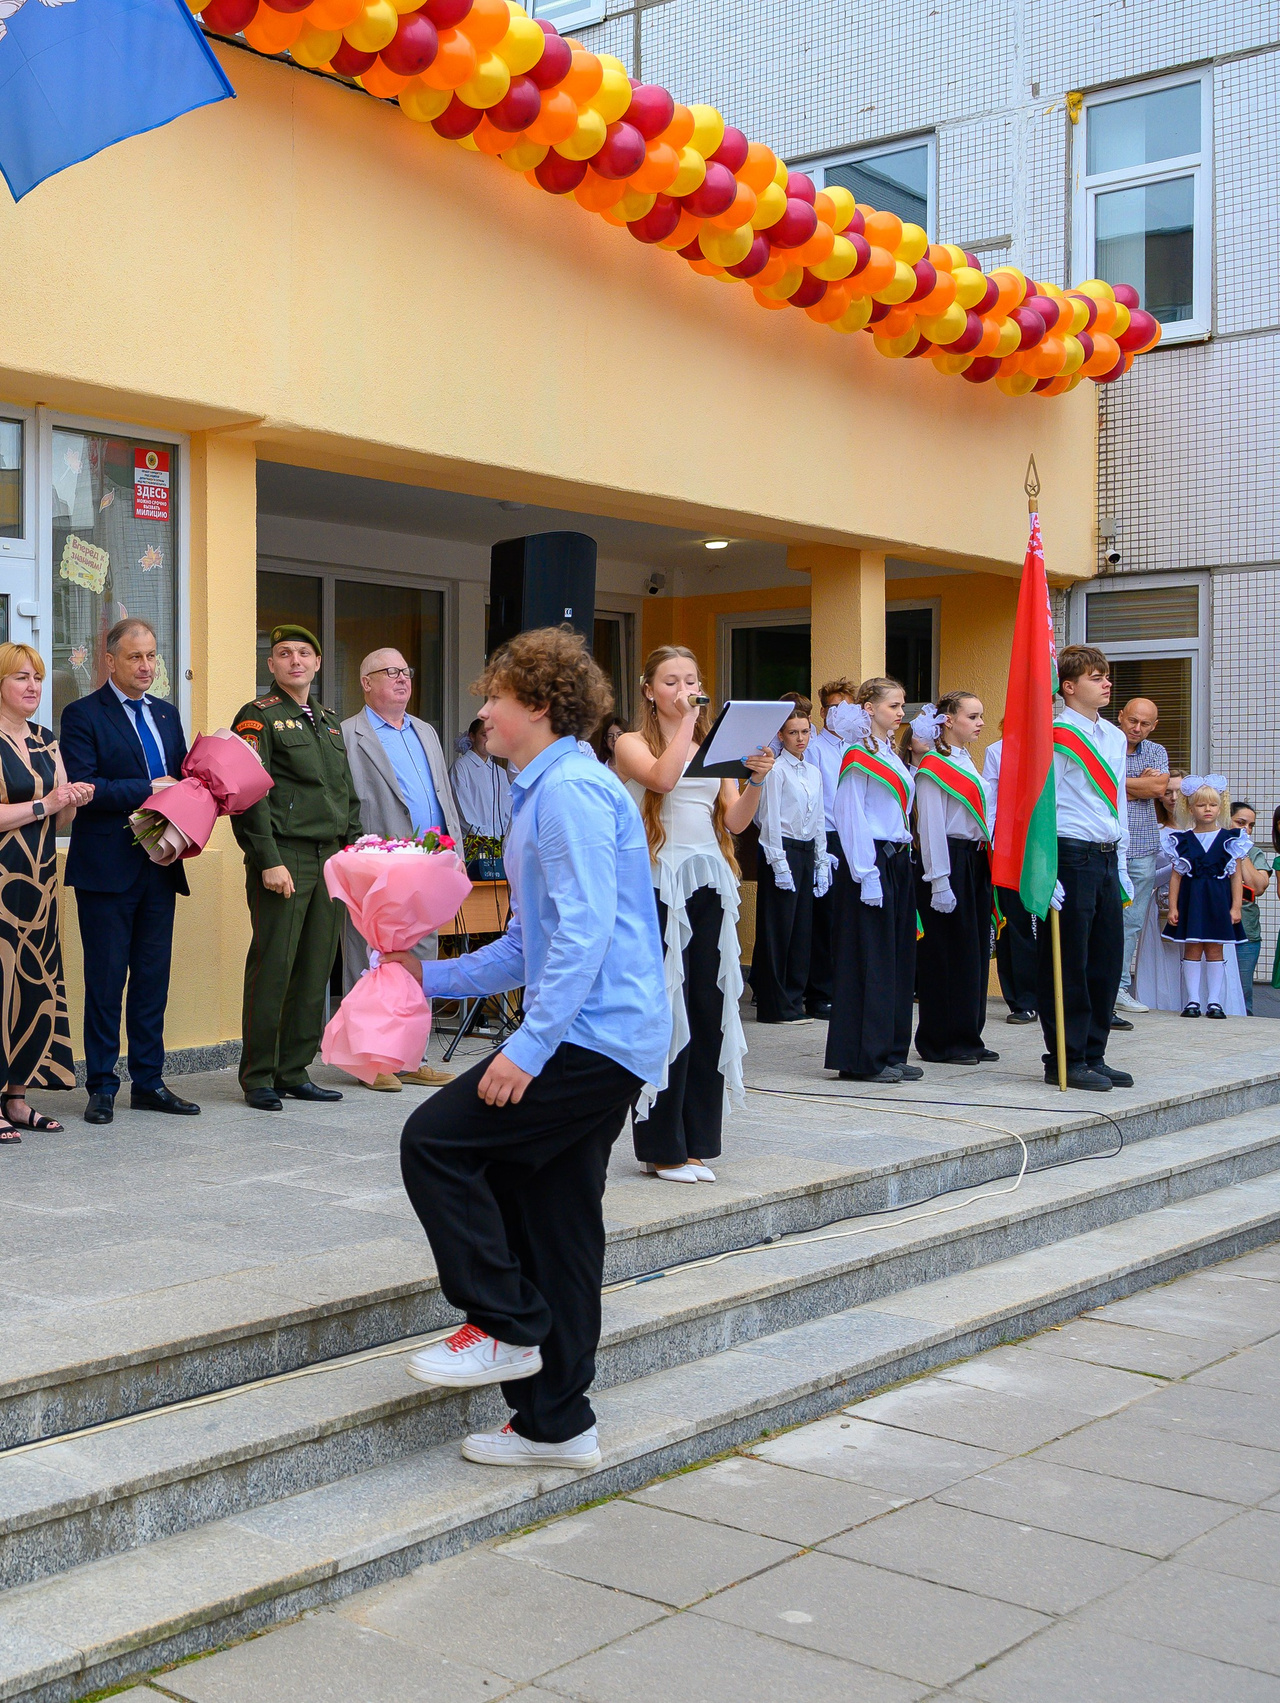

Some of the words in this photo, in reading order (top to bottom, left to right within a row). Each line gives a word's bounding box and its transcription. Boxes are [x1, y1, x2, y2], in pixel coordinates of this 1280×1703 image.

[137, 485, 167, 499] ЗДЕСЬ
[136, 509, 167, 518] МИЛИЦИЮ
[72, 539, 98, 560] Вперёд
[71, 552, 102, 571] знаниям!
